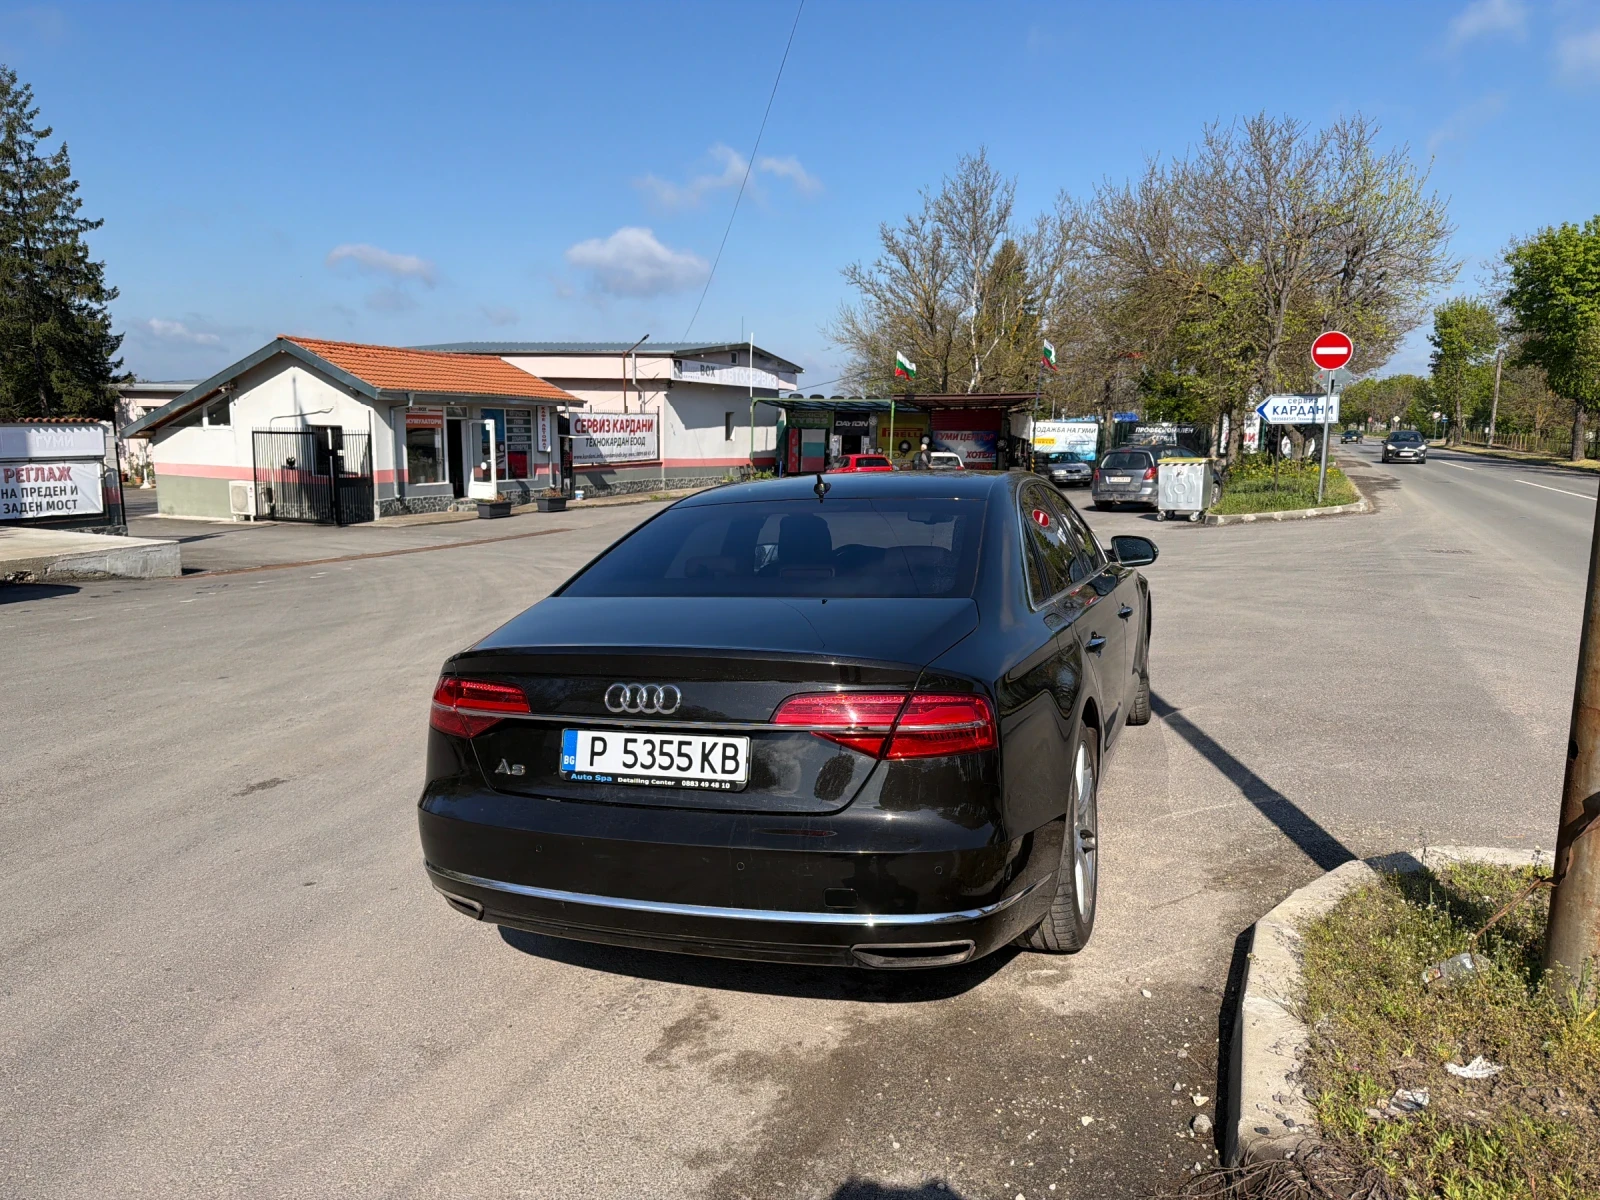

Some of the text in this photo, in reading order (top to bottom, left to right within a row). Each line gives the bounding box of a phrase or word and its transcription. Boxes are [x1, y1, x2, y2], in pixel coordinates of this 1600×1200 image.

[1272, 405, 1334, 416] КАРДАНИ
[574, 418, 654, 435] СЕРВИЗ КАРДАНИ
[881, 427, 924, 438] PIRELLI
[36, 435, 75, 448] ГУМИ
[585, 436, 646, 448] ТЕХНОКАРДАН ЕООД
[935, 432, 995, 442] ГУМИ ЦЕНТЪР
[3, 466, 73, 484] РЕГЛАЖ
[0, 485, 79, 499] НА ПРЕДЕН И
[3, 499, 78, 514] ЗАДЕН МОСТ
[563, 736, 740, 775] BG P 5355 KB
[570, 773, 593, 781] Auto
[595, 774, 613, 783] Spa
[617, 777, 650, 786] Detailing
[681, 780, 699, 788] 0883
